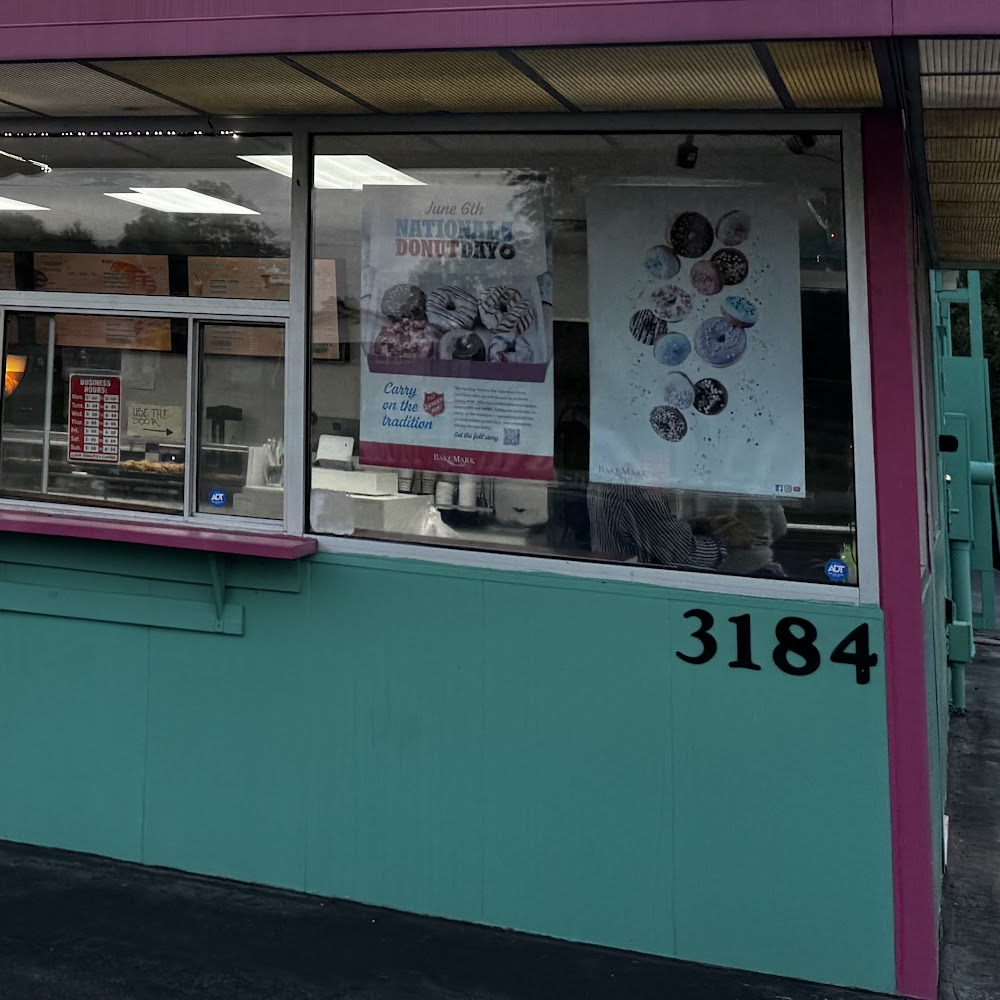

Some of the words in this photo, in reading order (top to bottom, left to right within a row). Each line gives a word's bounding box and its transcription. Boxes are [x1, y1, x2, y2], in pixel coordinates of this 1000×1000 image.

[424, 200, 457, 215] June
[460, 200, 485, 216] 6th
[395, 217, 499, 239] NATIONAL
[395, 238, 460, 258] DONUT
[461, 240, 499, 259] DAY
[80, 379, 111, 387] BUSINESS
[384, 382, 417, 398] Carry
[132, 407, 149, 418] USE
[151, 408, 168, 419] THE
[382, 402, 396, 411] on
[399, 400, 418, 412] the
[382, 414, 433, 430] tradition
[210, 493, 224, 501] ADT
[827, 565, 845, 574] ADT
[675, 608, 878, 685] 3184
